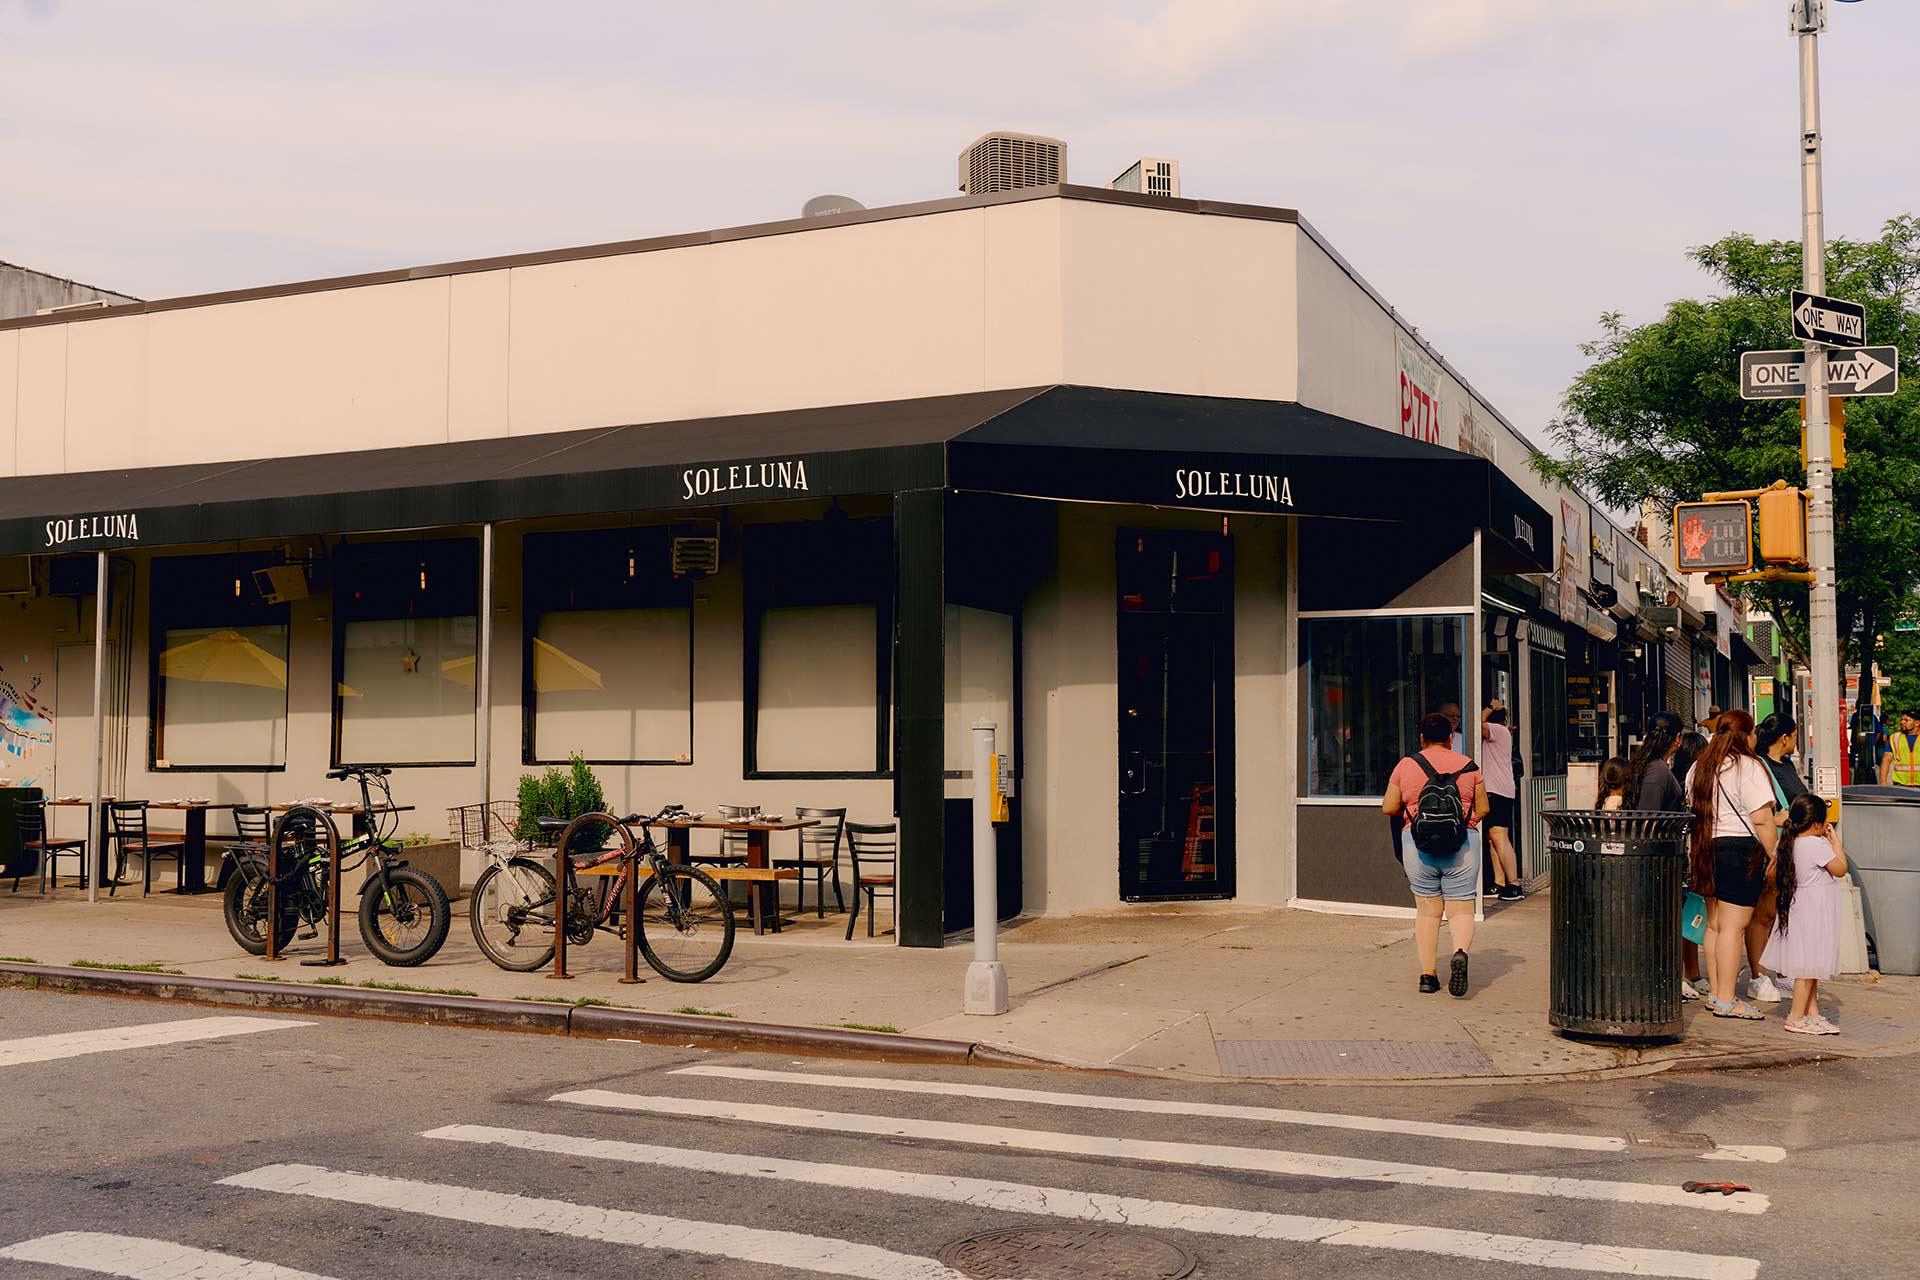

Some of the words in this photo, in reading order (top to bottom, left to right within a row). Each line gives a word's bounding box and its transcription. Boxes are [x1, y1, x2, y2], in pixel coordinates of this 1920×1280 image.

[1803, 307, 1825, 328] ONE
[1836, 315, 1859, 335] WAY
[1756, 365, 1800, 384] ONE
[1828, 362, 1875, 381] WAY
[683, 461, 809, 500] SOLELUNA
[1174, 469, 1294, 508] SOLELUNA
[45, 514, 139, 547] SOLELUNA
